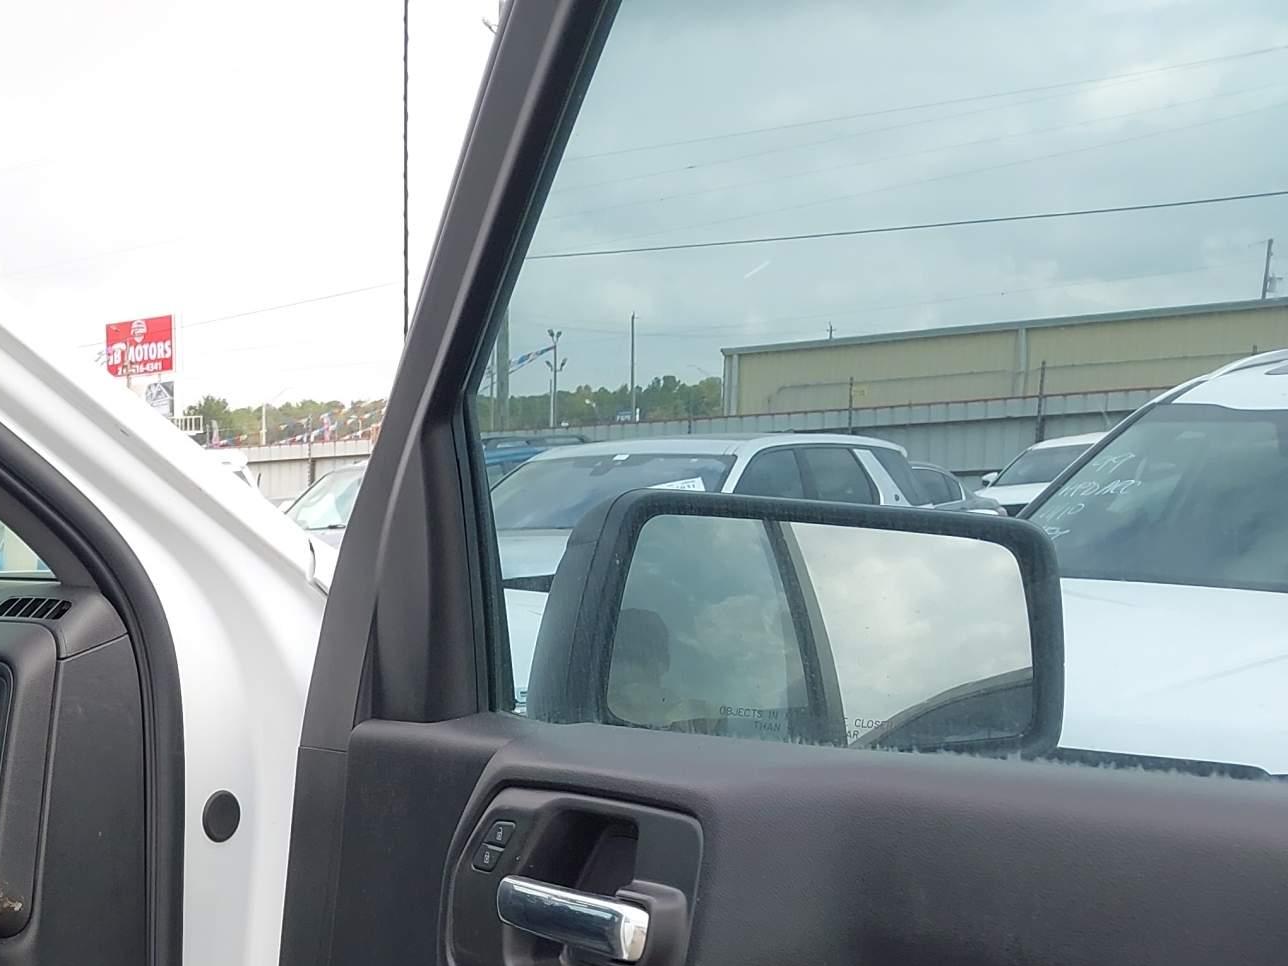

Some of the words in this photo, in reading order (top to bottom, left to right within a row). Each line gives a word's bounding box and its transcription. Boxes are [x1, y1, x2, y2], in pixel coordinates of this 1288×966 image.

[719, 705, 762, 719] OBJECTS
[768, 710, 779, 720] IN
[753, 720, 782, 732] THAN
